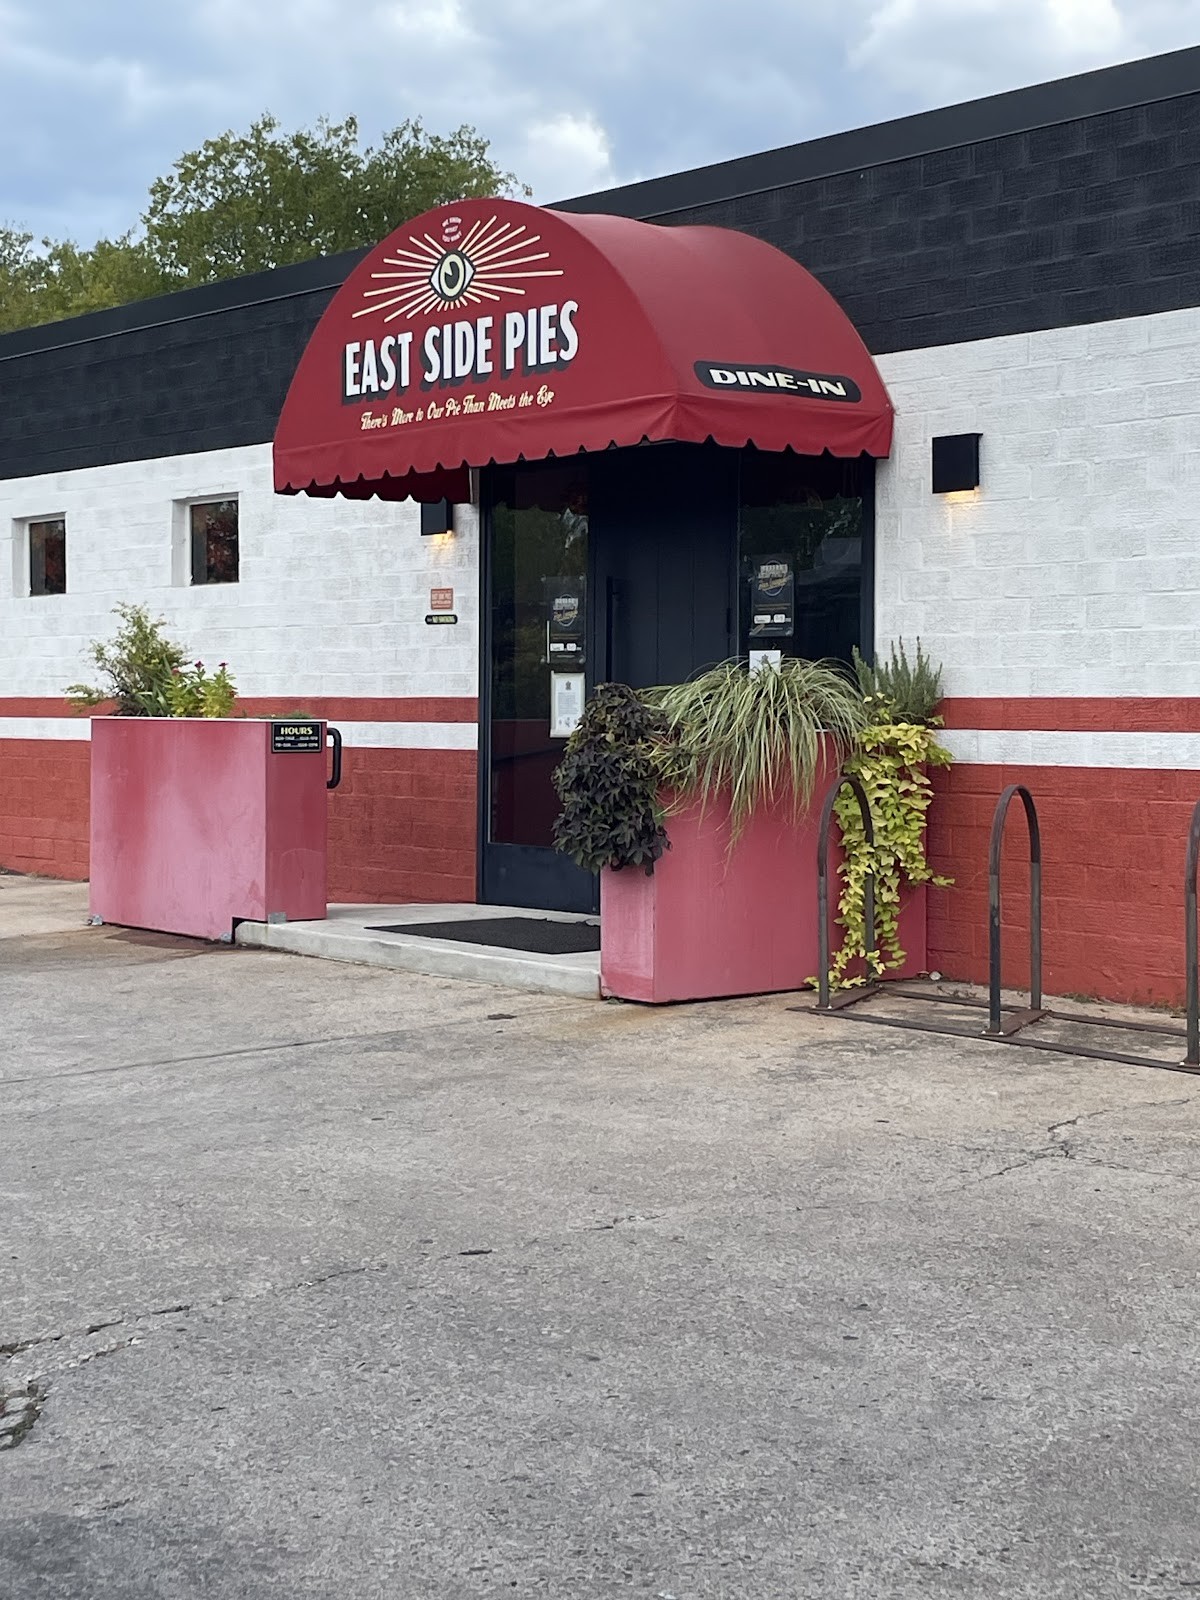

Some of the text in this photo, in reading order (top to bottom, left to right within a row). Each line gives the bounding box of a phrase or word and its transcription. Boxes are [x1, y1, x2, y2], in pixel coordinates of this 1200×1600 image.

[345, 300, 579, 397] EAST SIDE PIES
[709, 369, 847, 396] DINE-IN
[360, 385, 555, 430] There's More to Our Pie Than Meets the Eye
[281, 727, 313, 735] HOURS
